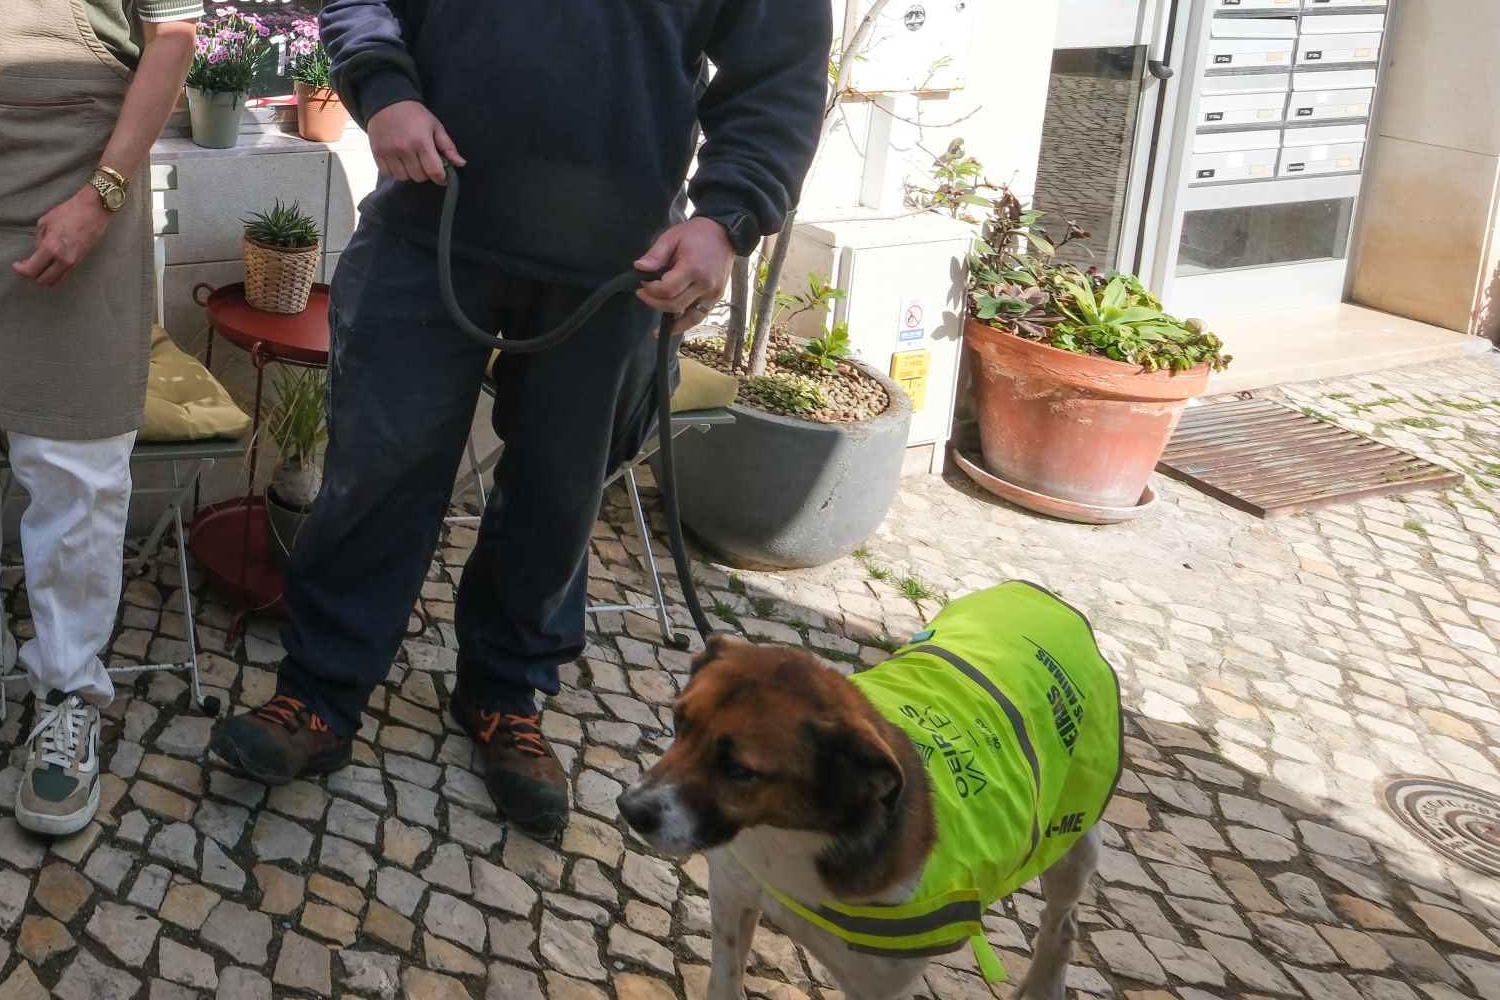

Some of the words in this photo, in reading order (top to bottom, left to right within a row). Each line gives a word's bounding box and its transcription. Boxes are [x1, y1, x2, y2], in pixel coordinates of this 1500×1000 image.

[1035, 649, 1079, 706] ANIMAIS
[899, 705, 969, 798] OEIRAS
[923, 706, 987, 795] VALLEY
